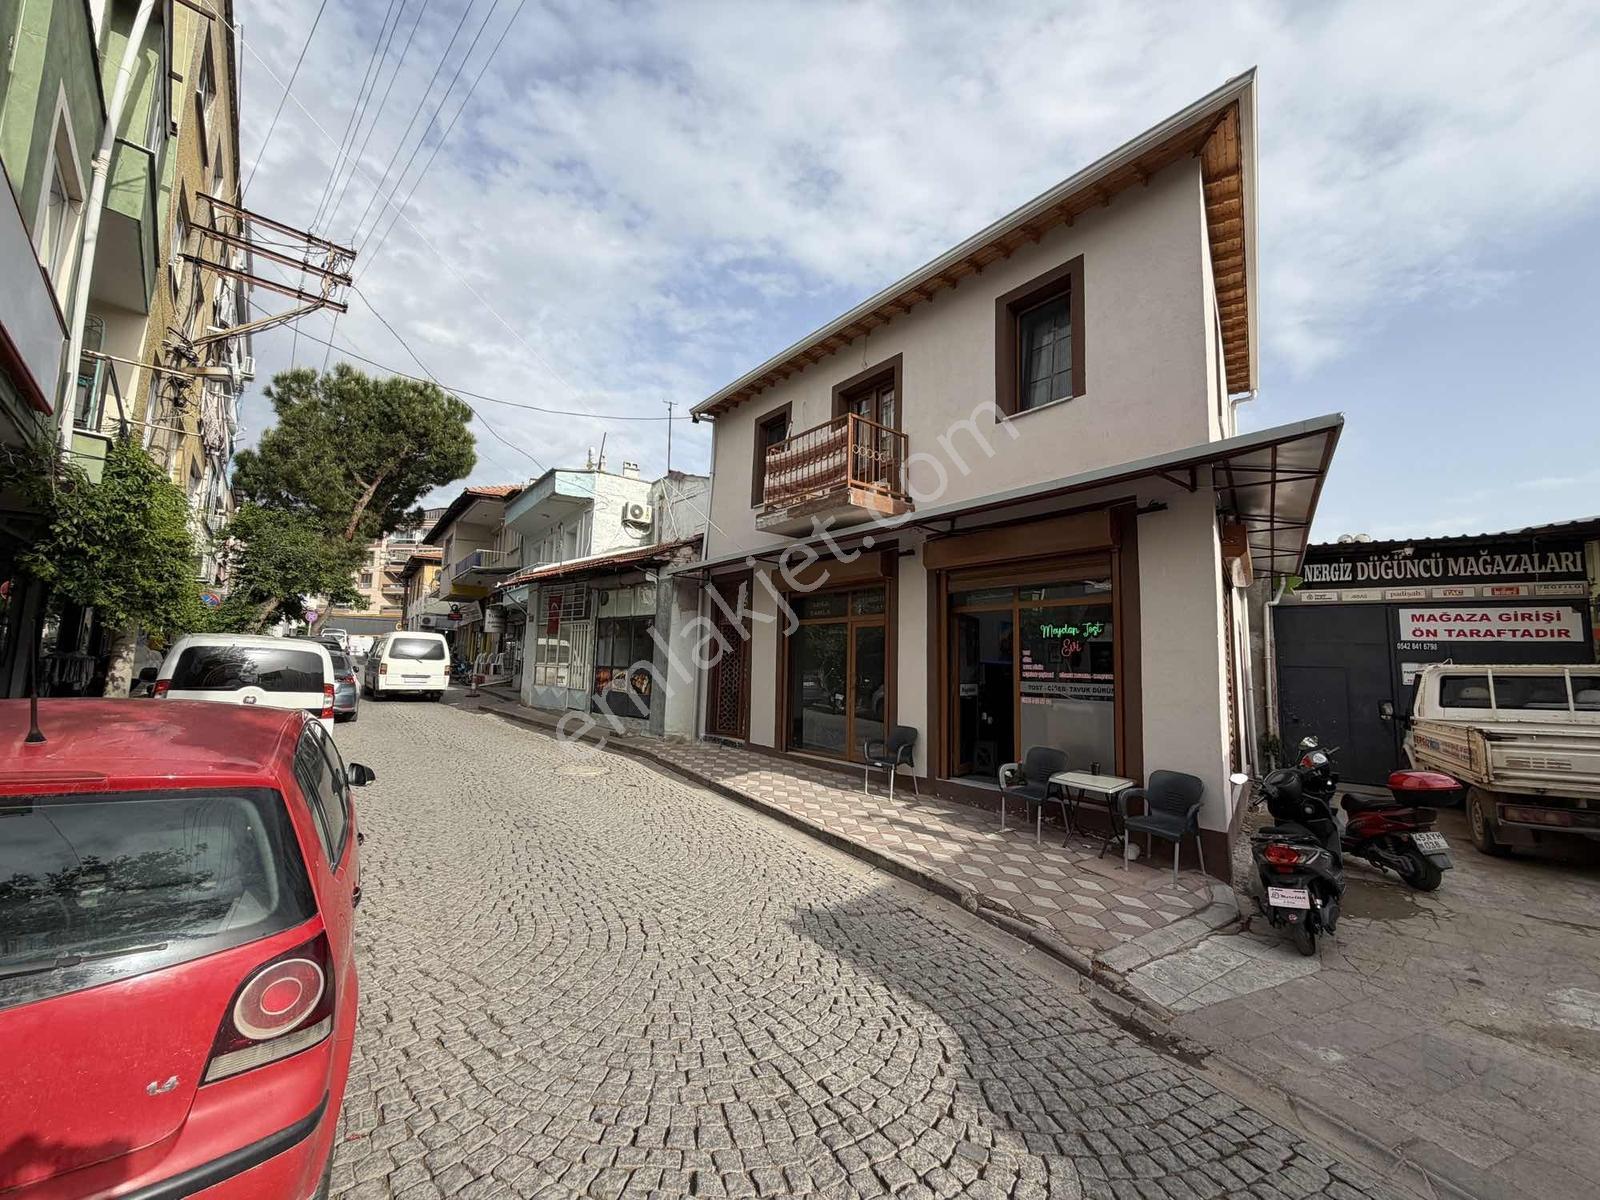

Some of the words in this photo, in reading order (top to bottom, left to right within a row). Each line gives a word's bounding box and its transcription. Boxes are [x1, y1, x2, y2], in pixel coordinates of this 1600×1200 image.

[1303, 557, 1353, 582] NERGİZ
[1356, 552, 1443, 580] DÜĞÜNCÜ
[1447, 549, 1583, 577] MAĞAZALARI
[1410, 612, 1492, 623] MAĞAZA
[1498, 610, 1562, 625] GİRİŞİ
[1411, 627, 1438, 638] ÖN
[1444, 628, 1571, 639] TARAFTADIR
[1061, 638, 1082, 657] Evi
